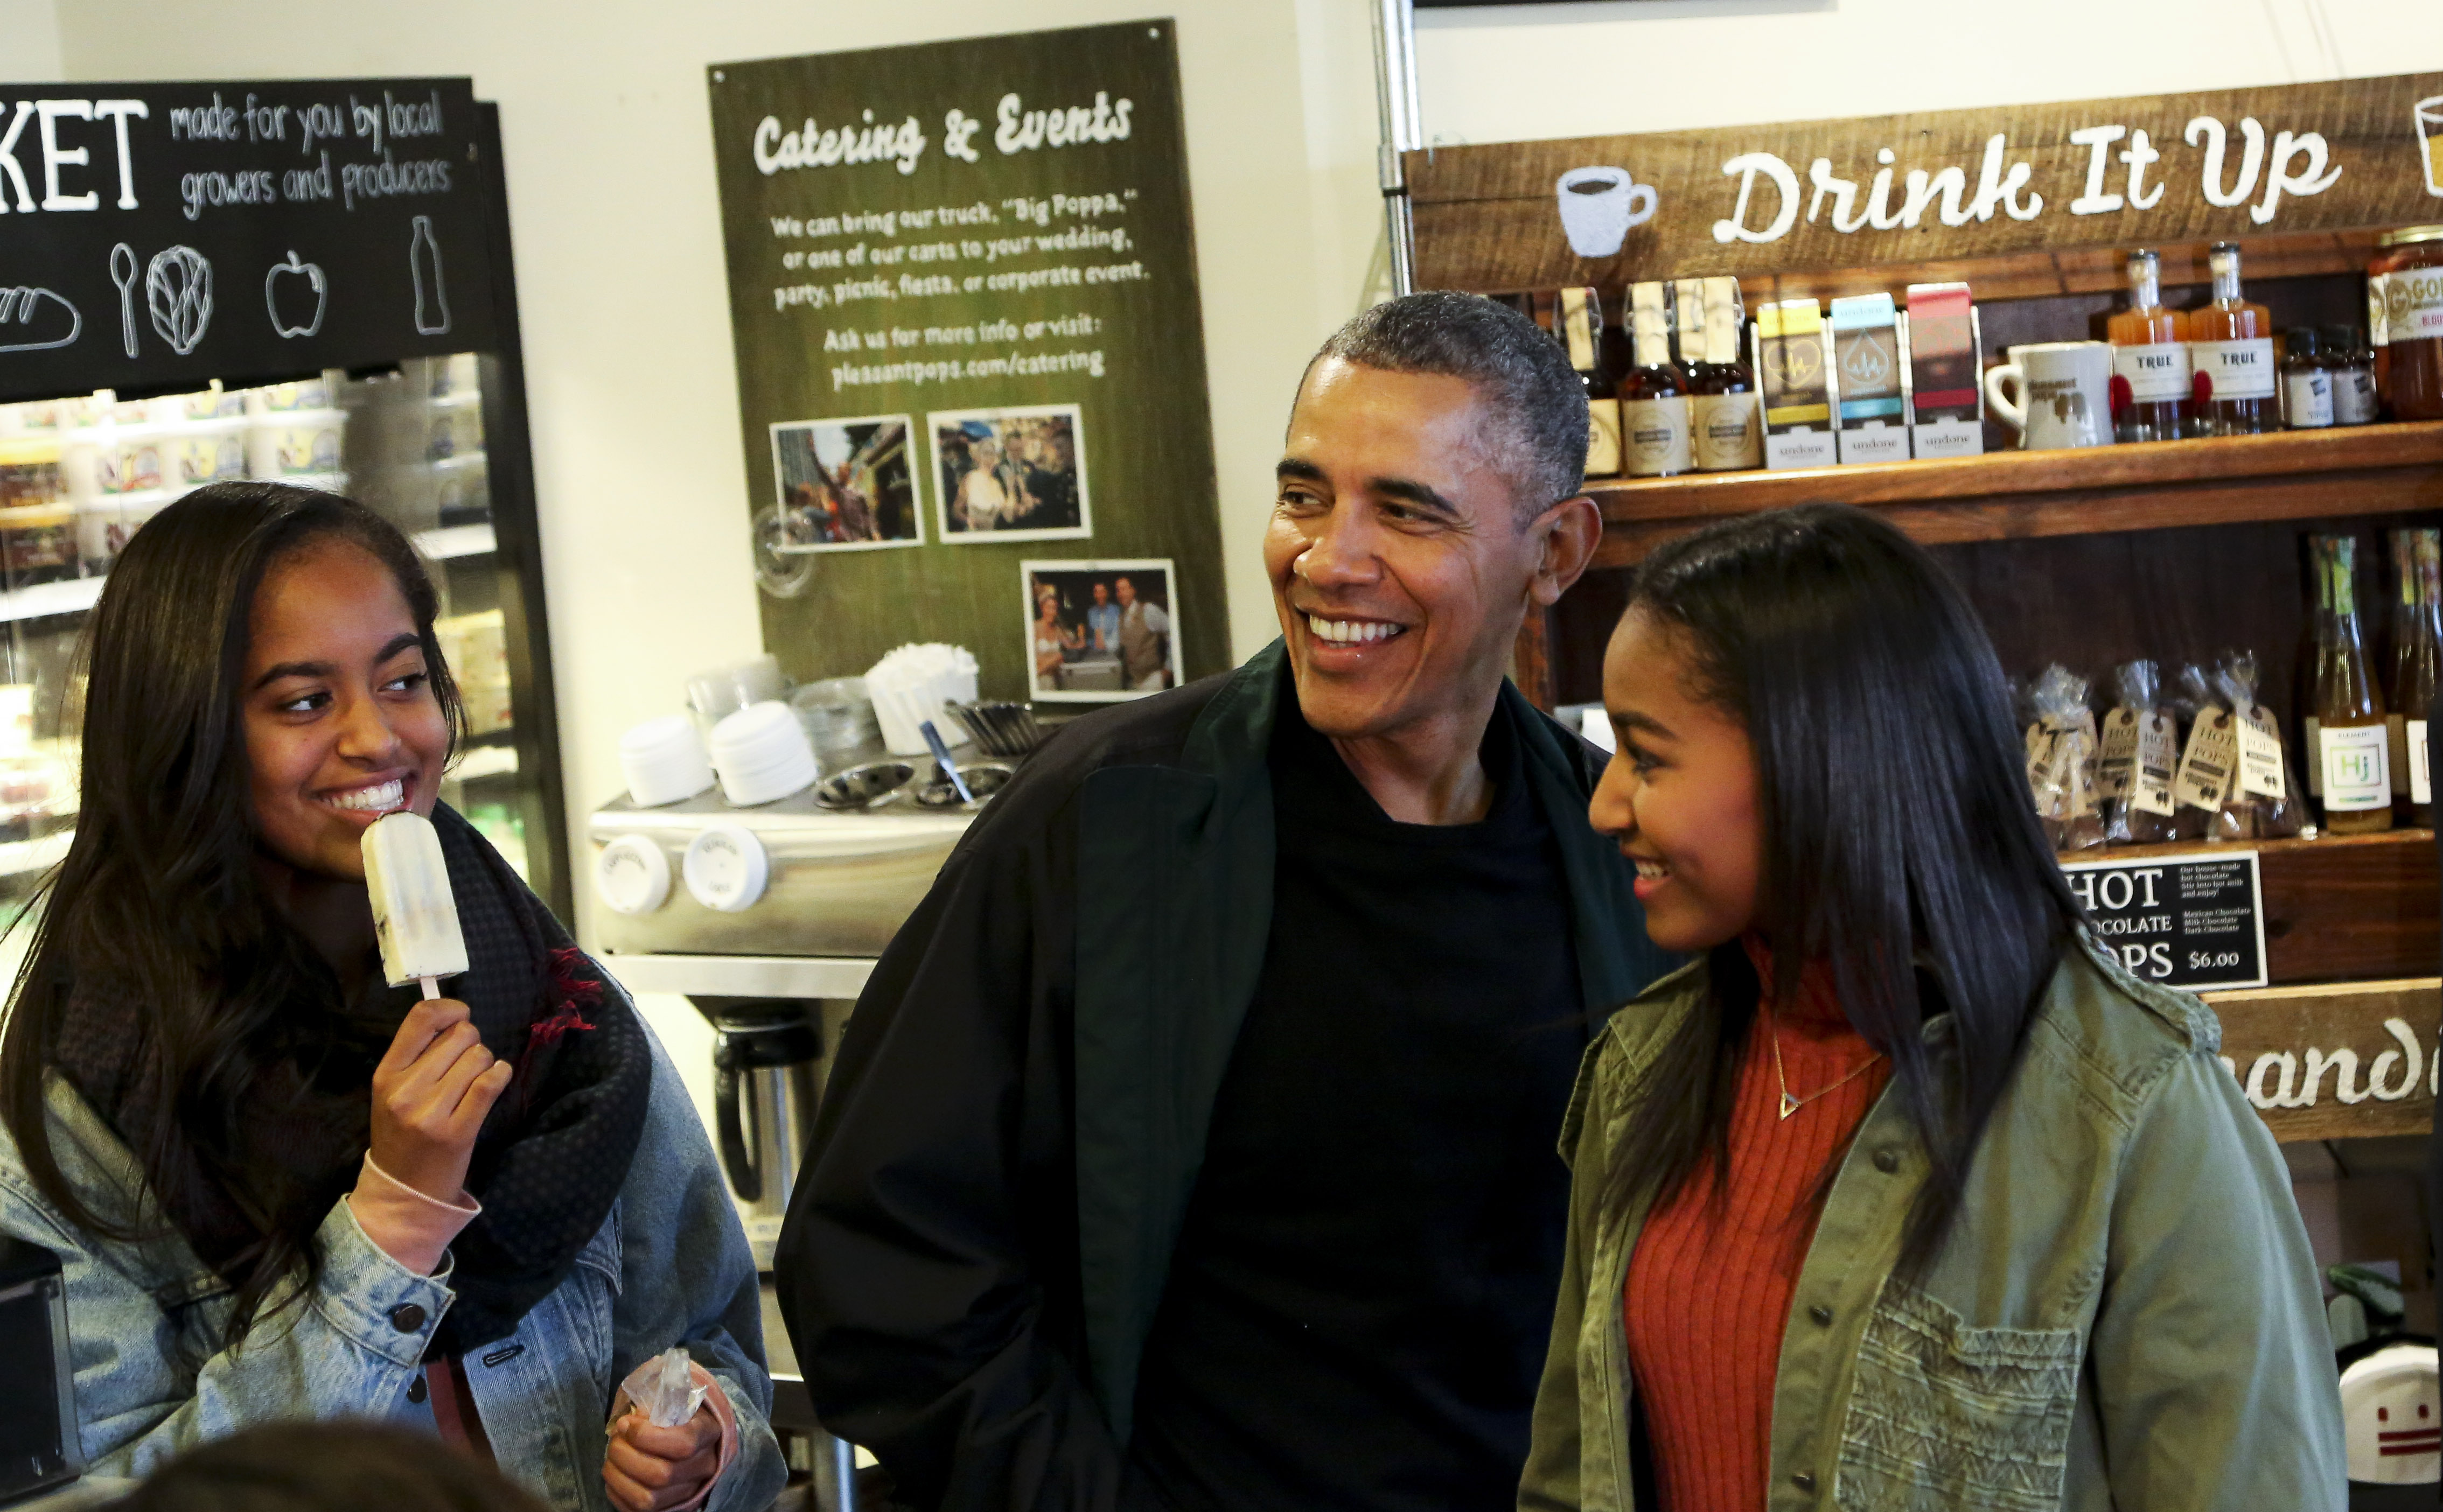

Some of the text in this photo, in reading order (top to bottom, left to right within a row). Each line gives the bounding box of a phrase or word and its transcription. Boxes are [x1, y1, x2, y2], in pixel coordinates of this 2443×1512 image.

[170, 89, 444, 156] made for you by local
[753, 90, 1134, 176] Catering & Events
[182, 145, 453, 221] growers and producers
[1712, 115, 2343, 244] Drink It Up
[770, 215, 803, 237] We
[806, 216, 841, 237] can
[842, 210, 897, 237] bring
[899, 209, 935, 229] our
[783, 251, 805, 269] or
[807, 249, 843, 269] one
[846, 241, 865, 265] of
[870, 245, 906, 264] our
[909, 240, 957, 262] carts
[960, 239, 983, 258] to
[986, 235, 1031, 263] your
[964, 275, 984, 292] or
[987, 265, 1081, 293] corporate
[1085, 260, 1151, 284] event.
[824, 312, 1102, 353] Ask us for more info or visit:
[2137, 355, 2173, 369] TRUE
[2221, 351, 2258, 366] TRUE
[830, 350, 1105, 392] pleasantpops.com/catering
[1779, 443, 1825, 454] undone
[1852, 438, 1897, 449] undone
[1926, 433, 1970, 446] undone
[2200, 727, 2234, 745] HOT
[2195, 871, 2230, 880] chocolate
[2065, 869, 2162, 911] HOT
[2182, 890, 2196, 898] and
[2184, 907, 2251, 918] Mexican Chocolate
[2185, 916, 2238, 926] Milk Chocolate
[2092, 915, 2173, 935] COLATE
[2204, 924, 2240, 933] Chocolate
[2188, 950, 2240, 969] $6.00
[2219, 1017, 2440, 1109] and
